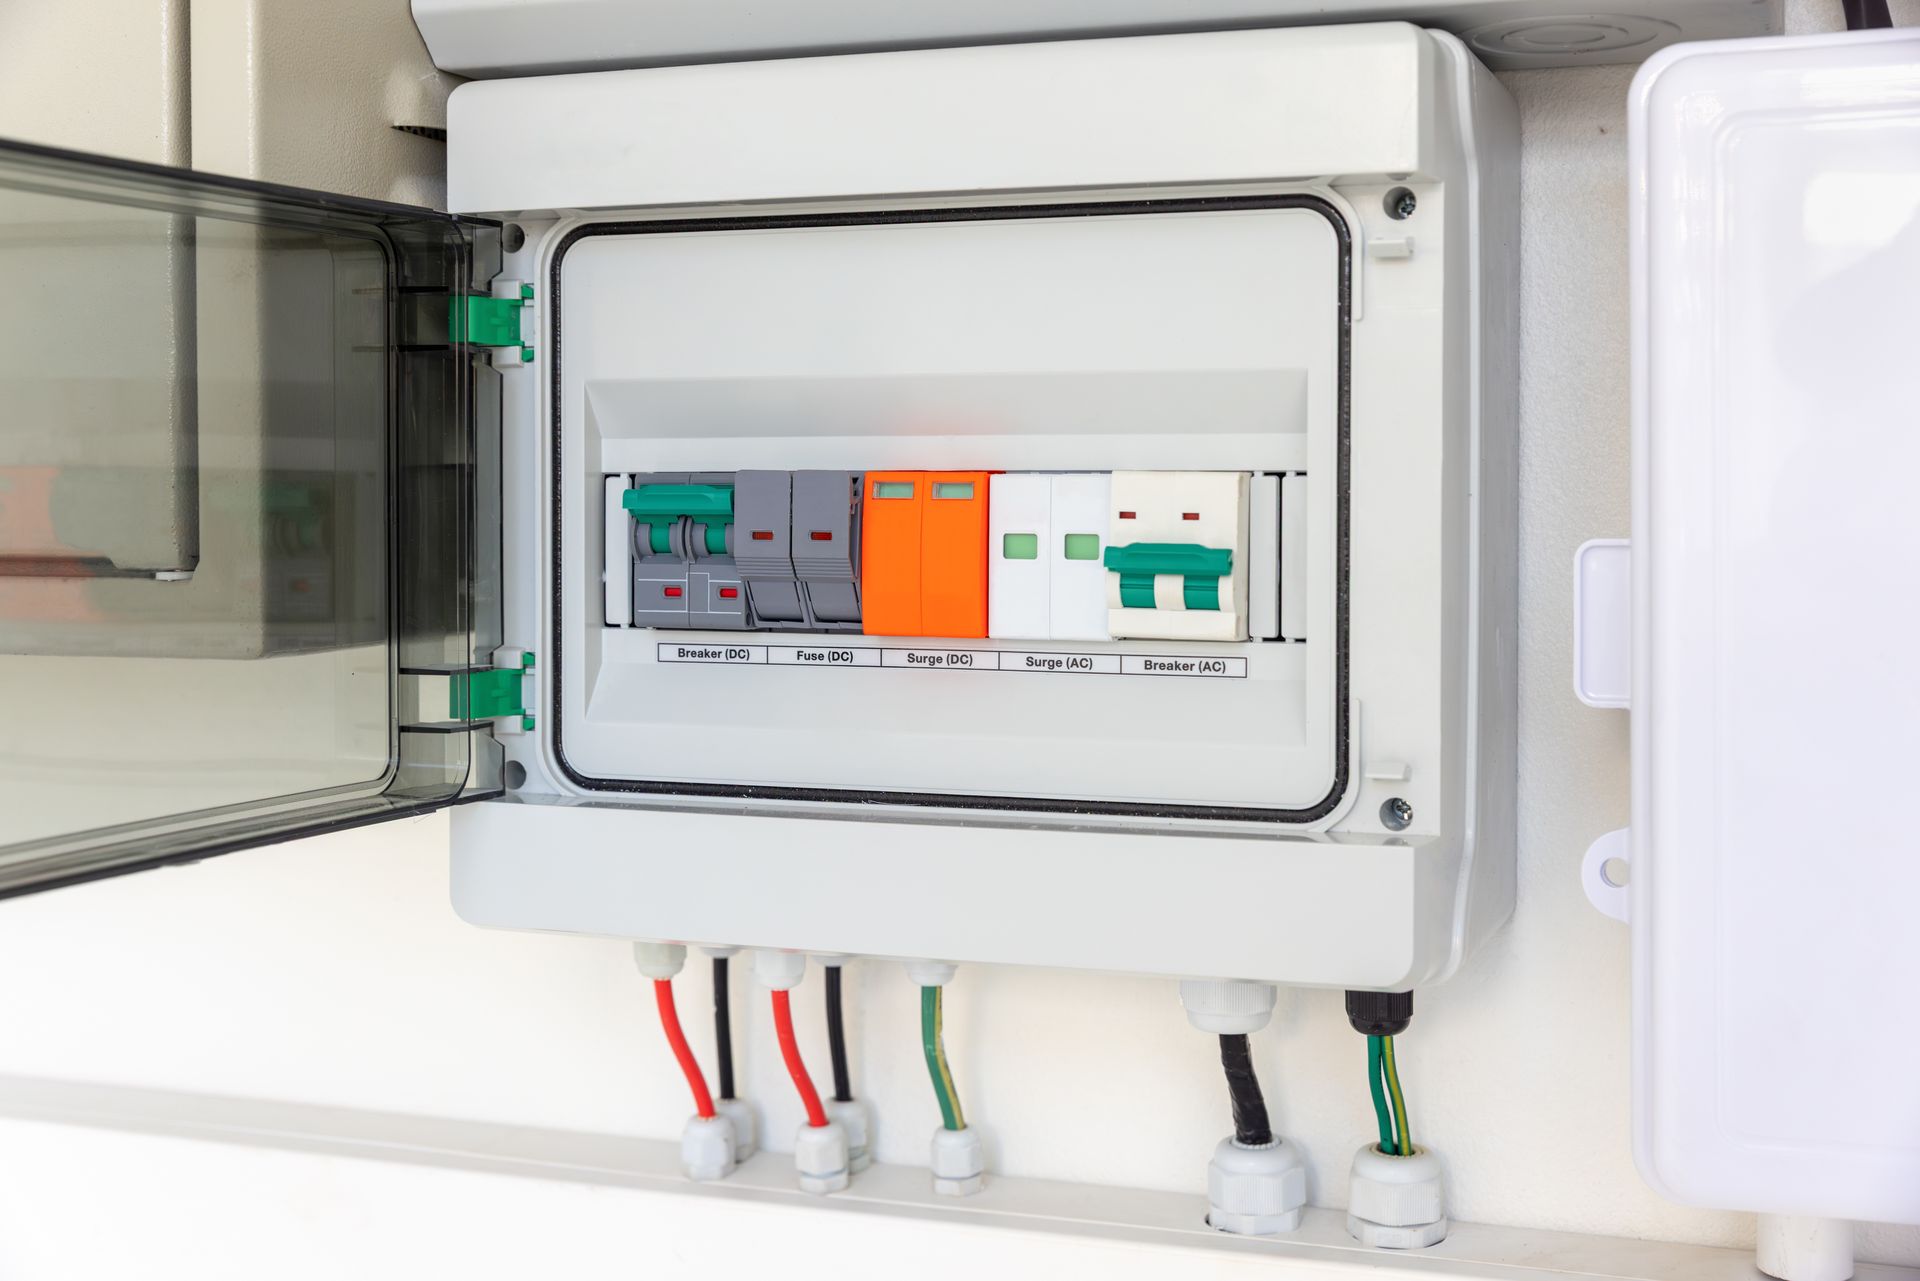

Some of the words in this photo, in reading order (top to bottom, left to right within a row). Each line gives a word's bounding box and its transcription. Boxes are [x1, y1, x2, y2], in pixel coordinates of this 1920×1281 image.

[677, 648, 723, 660] Breaker
[725, 648, 751, 661] (DC)
[796, 651, 825, 662] Fuse
[827, 651, 854, 663] (DC)
[907, 653, 944, 667] Surge
[946, 653, 973, 666] (DC)
[1025, 656, 1063, 670] Surge
[1066, 656, 1093, 670] (AC)
[1144, 659, 1196, 672] Breaker
[1198, 660, 1226, 673] (AC)
